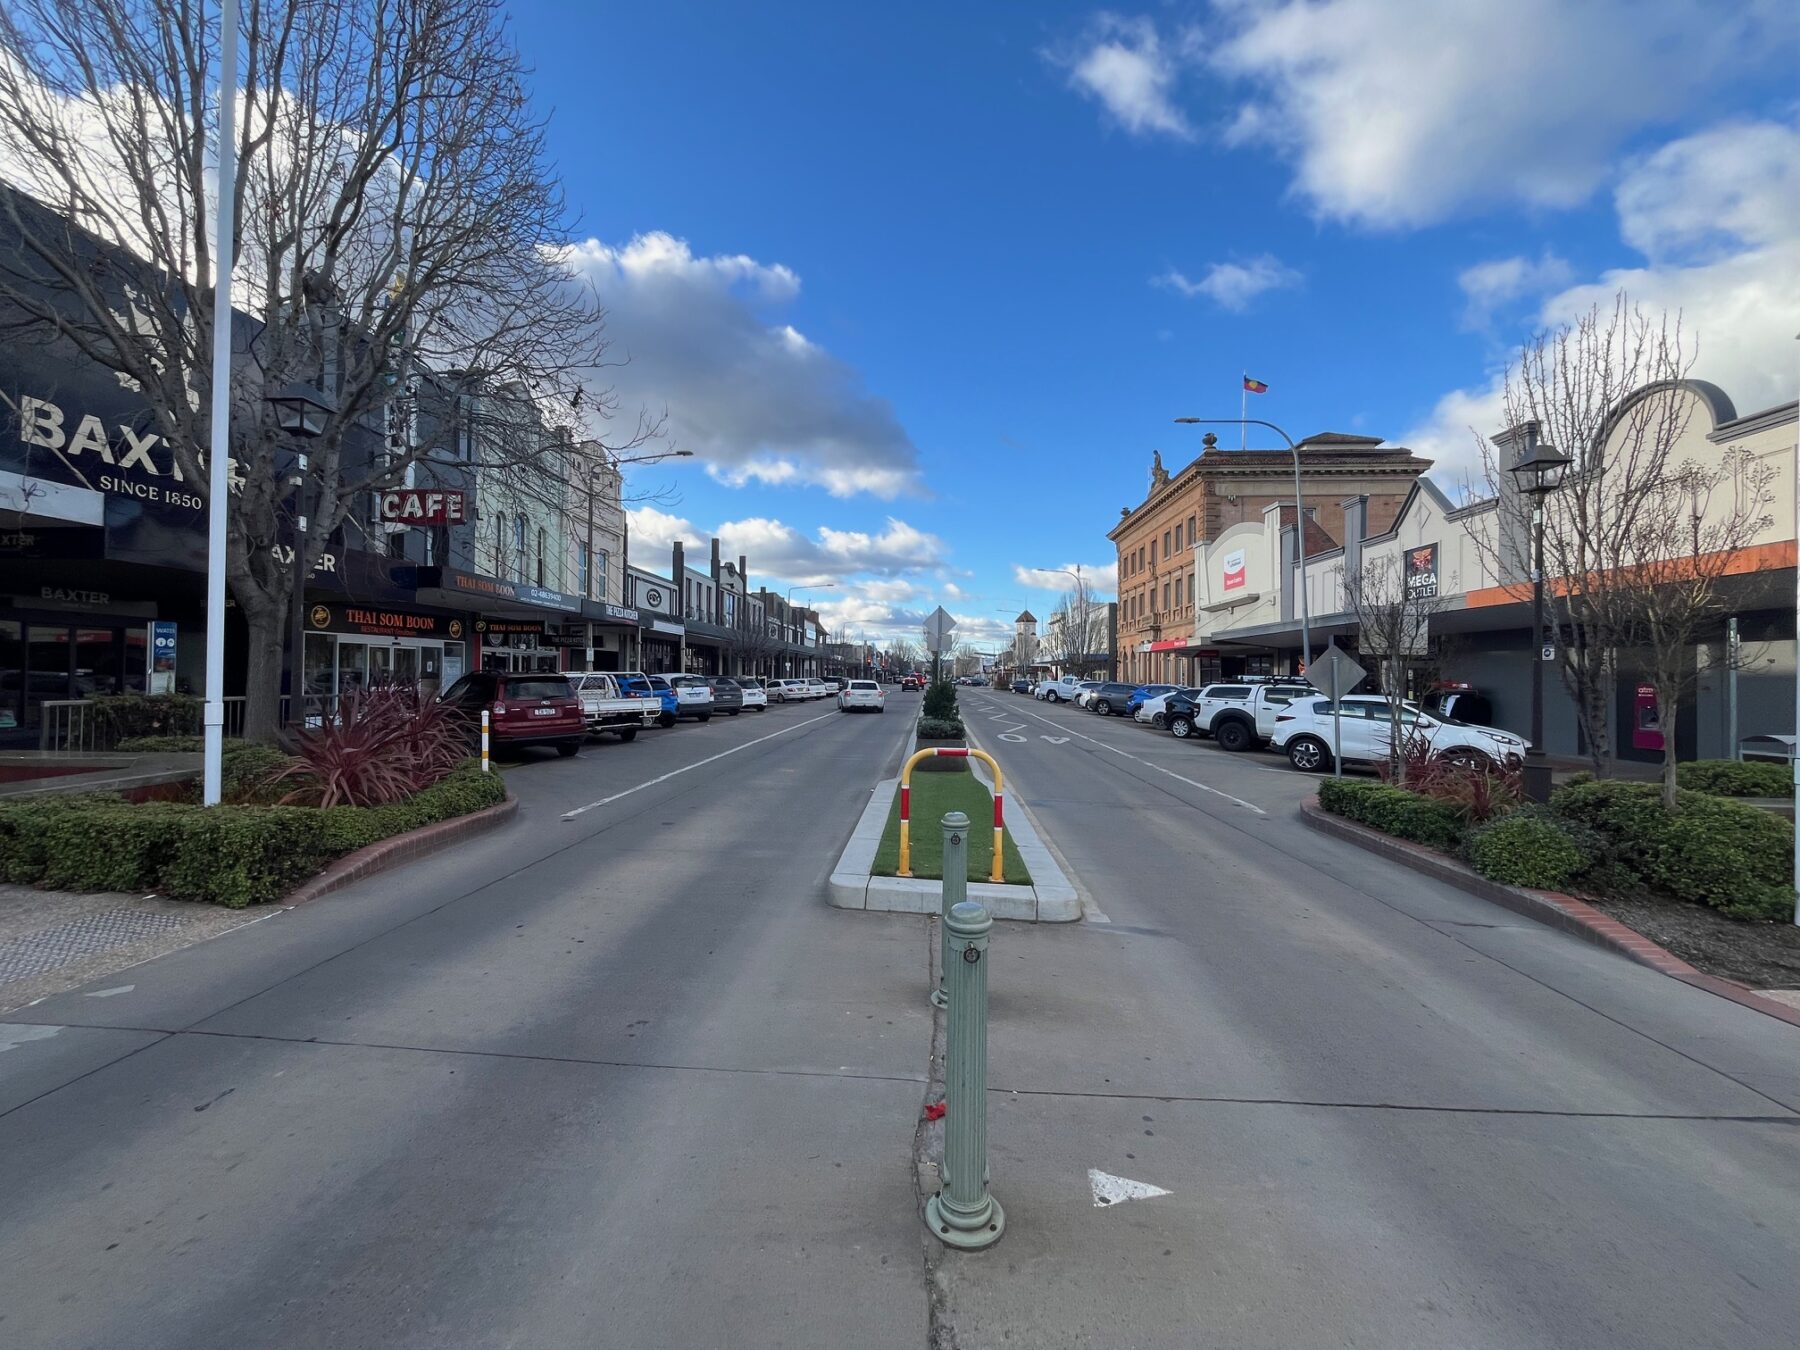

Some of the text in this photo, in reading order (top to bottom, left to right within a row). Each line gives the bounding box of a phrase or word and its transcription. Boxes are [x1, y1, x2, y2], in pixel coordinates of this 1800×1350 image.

[21, 395, 248, 498] BAX
[100, 475, 203, 510] SINCE 1850
[382, 493, 462, 519] CAFE
[456, 576, 515, 597] THAI SOM BOON
[1407, 572, 1437, 588] MEGA
[41, 585, 111, 605] BAXTER
[1407, 585, 1438, 599] OUTLET
[346, 609, 434, 630] THAI SOM BOON
[614, 606, 623, 618] PIZZA
[624, 607, 639, 621] KITCHEN
[489, 623, 542, 633] THAI SOM BOON
